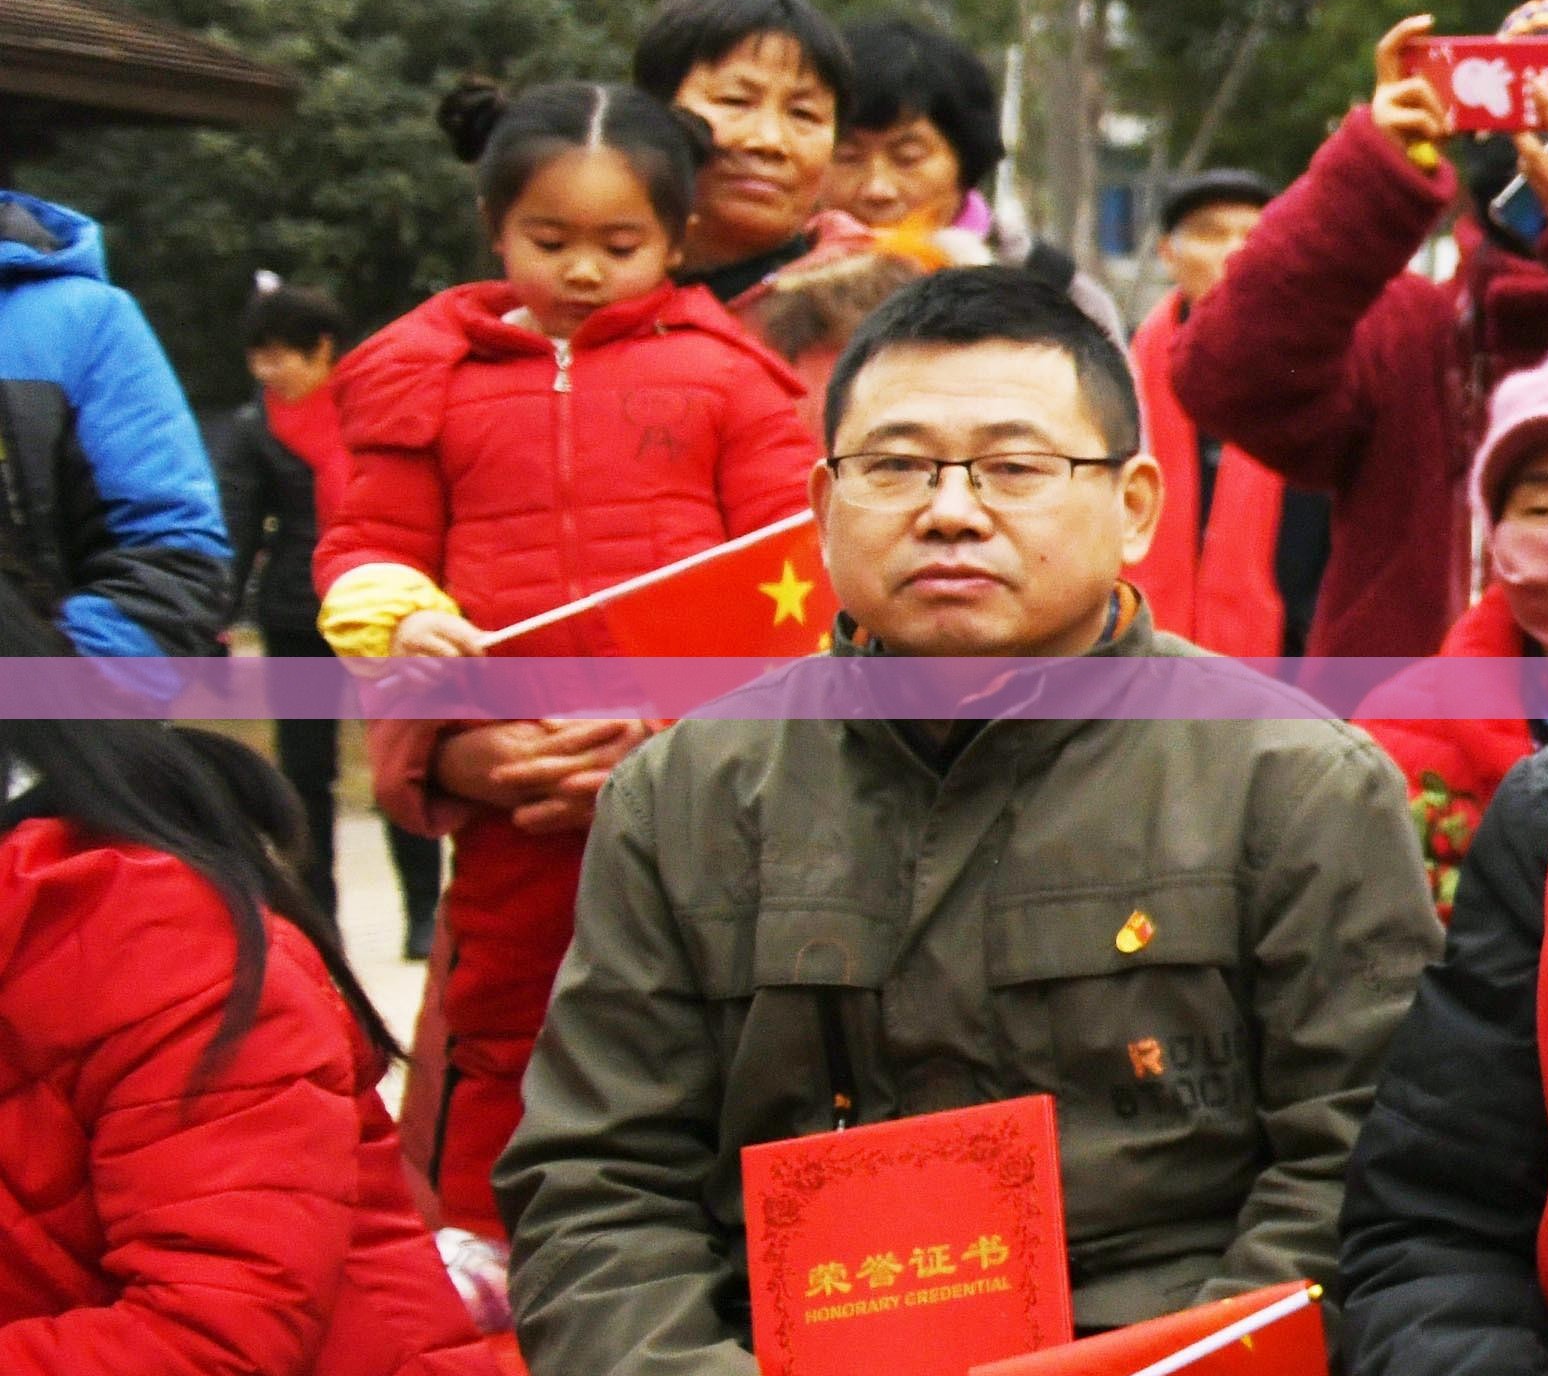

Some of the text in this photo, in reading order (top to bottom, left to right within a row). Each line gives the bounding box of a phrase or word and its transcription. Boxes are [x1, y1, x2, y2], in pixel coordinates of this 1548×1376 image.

[805, 1234, 1009, 1297] 荣誉证书
[805, 1276, 1013, 1324] HONORARY CREDENTIAL
